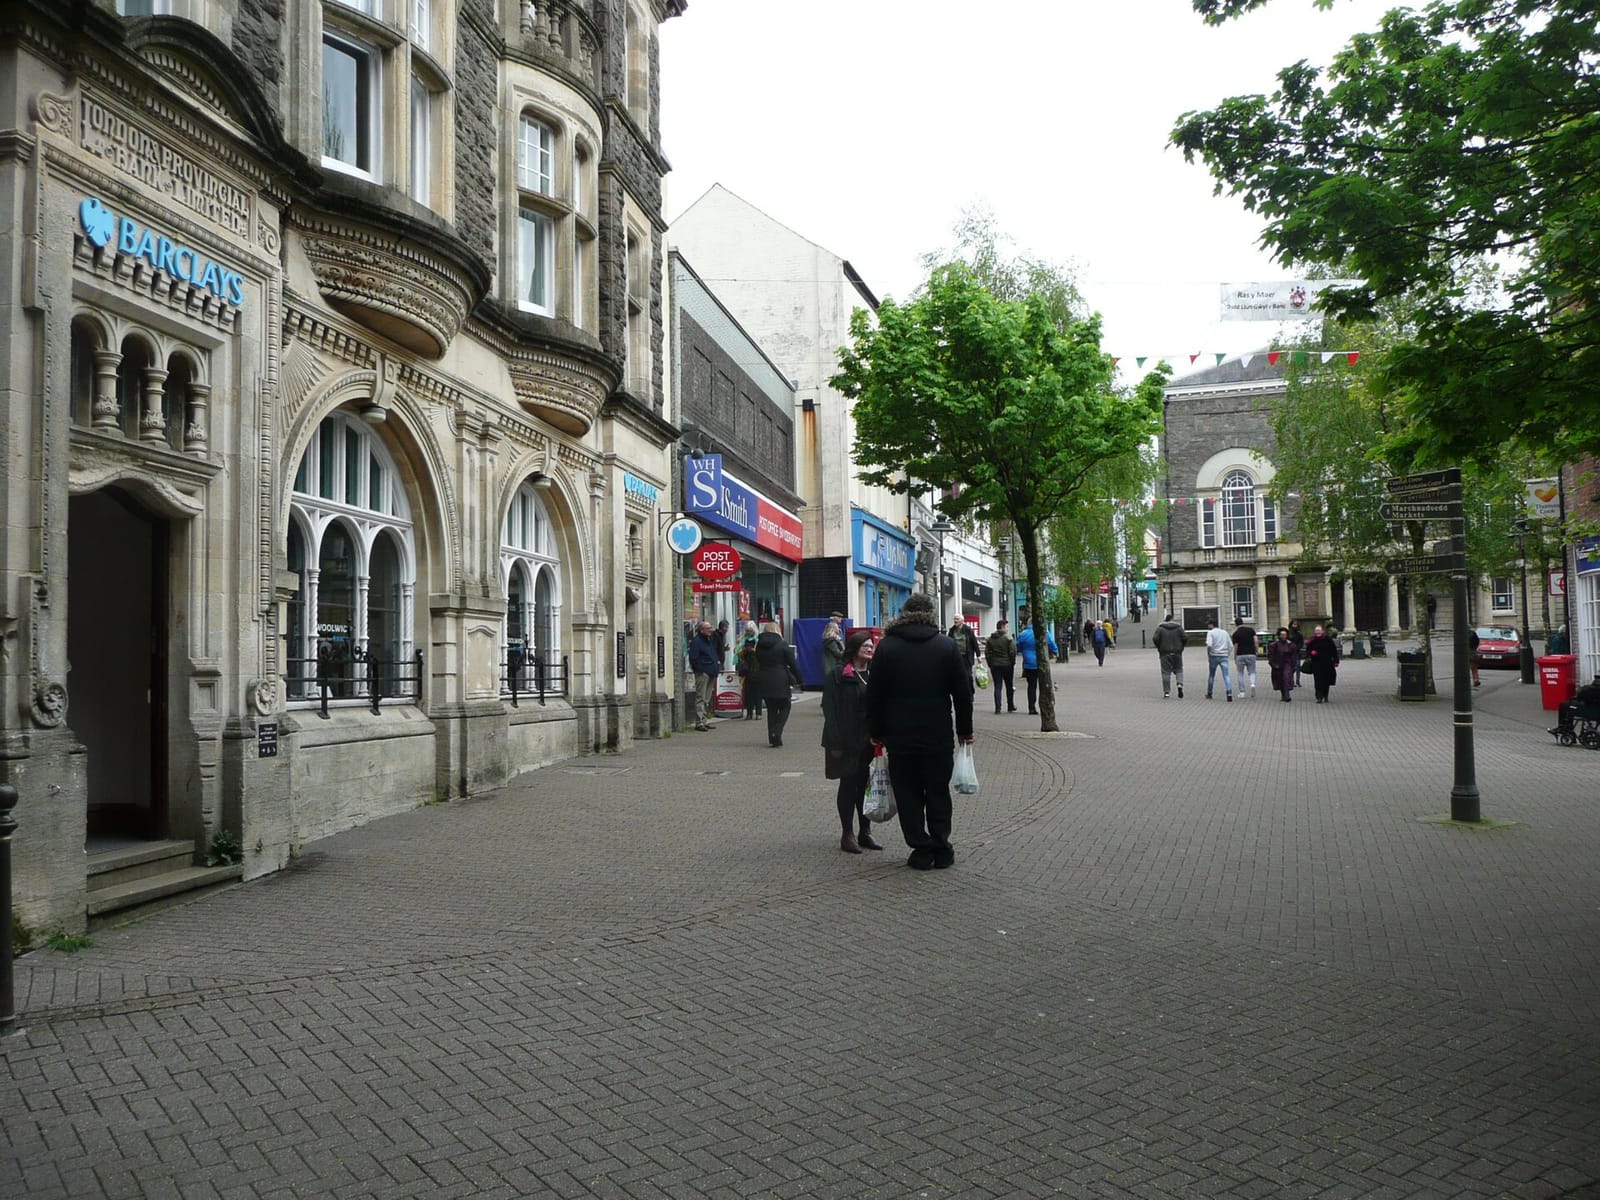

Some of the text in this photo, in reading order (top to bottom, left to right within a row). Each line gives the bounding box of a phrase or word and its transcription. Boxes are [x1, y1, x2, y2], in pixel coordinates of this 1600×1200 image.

[113, 144, 163, 193] BANK
[118, 216, 245, 305] BARCLAYS
[692, 458, 716, 471] WH
[693, 470, 718, 508] S
[703, 551, 731, 561] POST
[696, 561, 734, 571] OFFICE
[715, 583, 733, 591] Money
